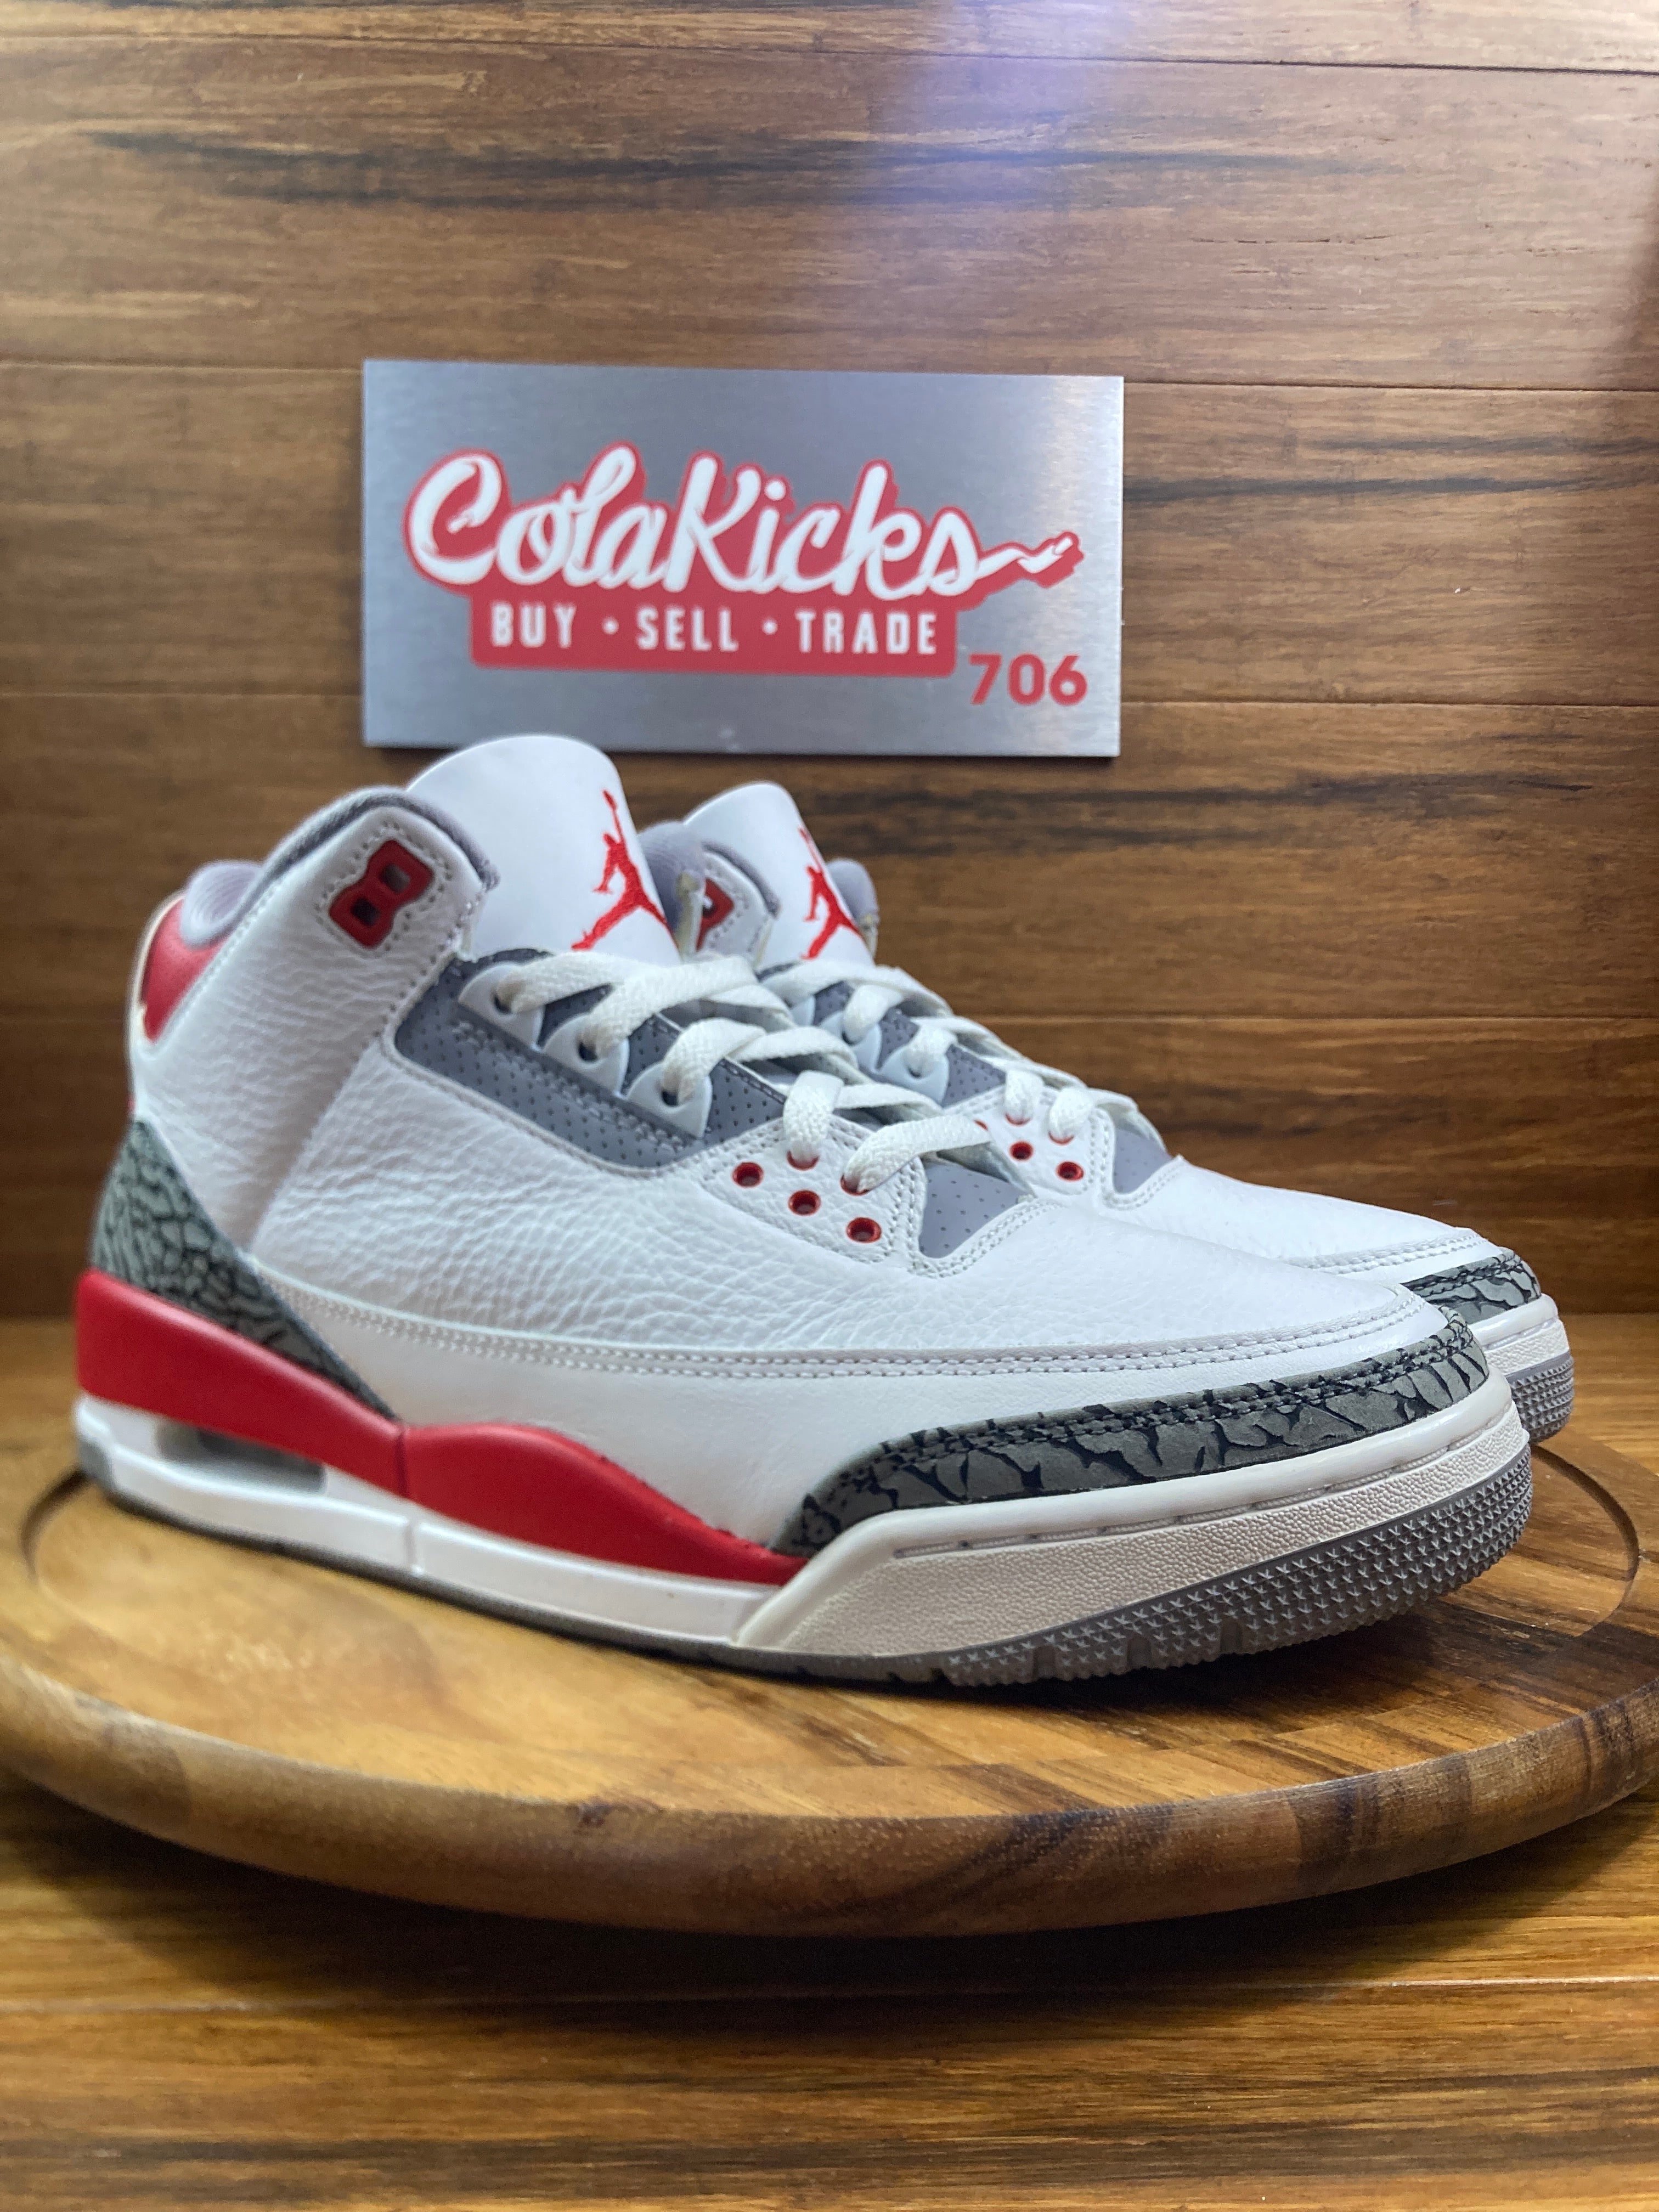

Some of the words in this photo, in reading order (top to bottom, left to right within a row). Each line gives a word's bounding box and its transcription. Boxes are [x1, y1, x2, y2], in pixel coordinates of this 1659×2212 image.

[406, 442, 1079, 601] ColaKicks
[490, 601, 577, 650] BUY
[636, 607, 740, 653] SELL
[795, 611, 937, 656] TRADE
[969, 654, 1088, 707] 706
